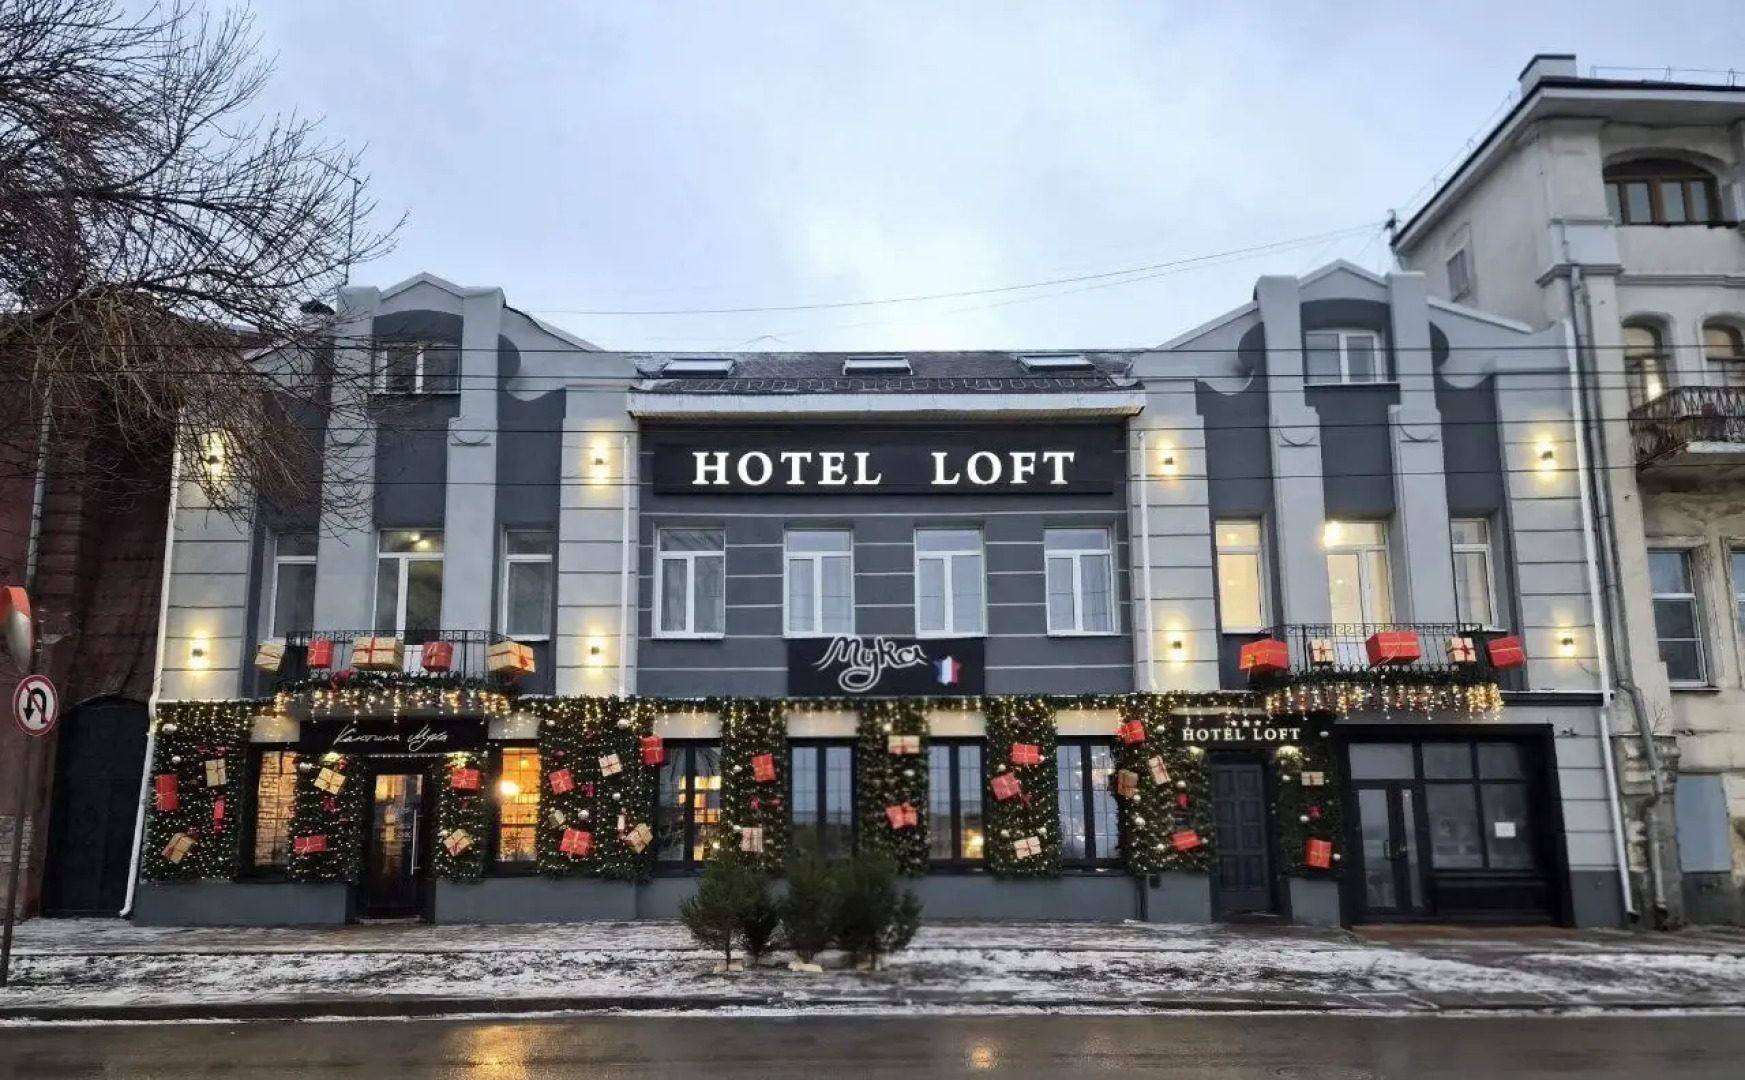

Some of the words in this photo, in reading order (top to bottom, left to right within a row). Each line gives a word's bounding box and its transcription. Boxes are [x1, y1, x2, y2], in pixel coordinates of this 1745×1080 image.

[692, 451, 882, 485] HOTEL
[931, 451, 1075, 485] LOFT
[1182, 728, 1246, 741] HOTEL
[1253, 728, 1300, 741] LOFT
